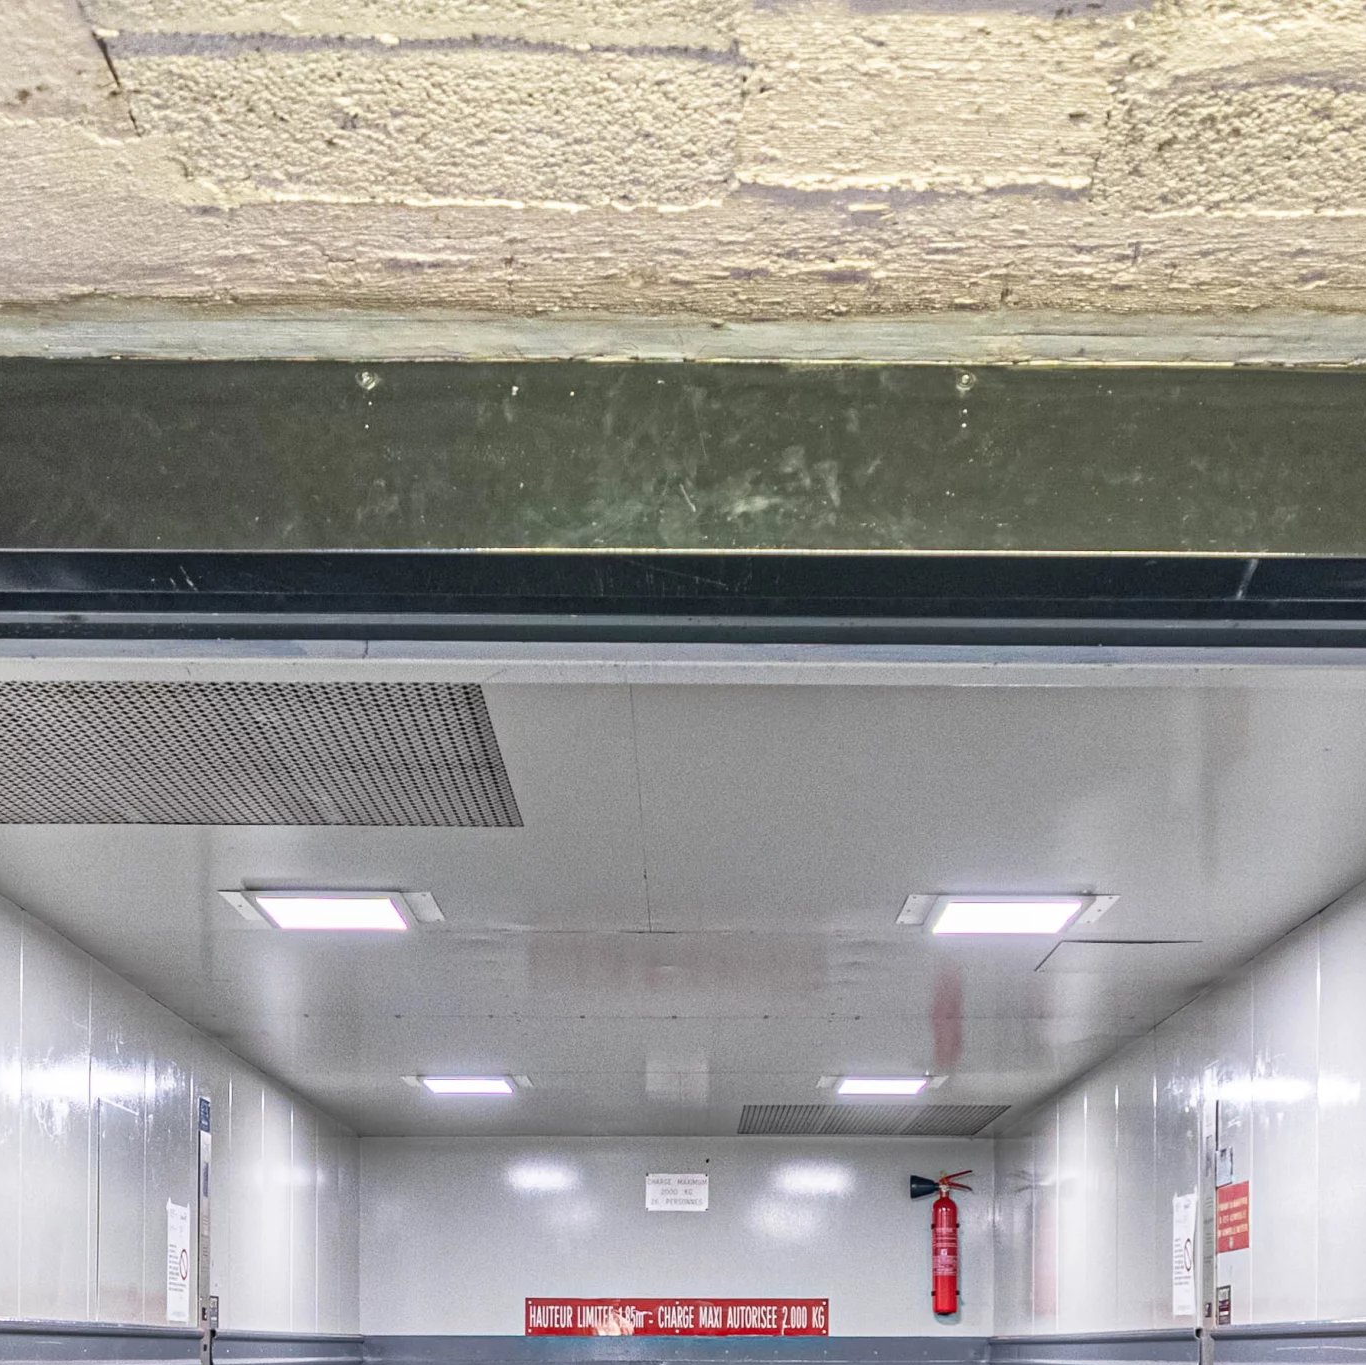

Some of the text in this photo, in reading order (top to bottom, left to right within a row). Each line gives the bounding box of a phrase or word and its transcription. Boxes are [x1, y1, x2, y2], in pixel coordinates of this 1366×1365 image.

[529, 1305, 573, 1329] HAUTEUR
[657, 1305, 695, 1329] CHARGE
[698, 1306, 723, 1329] MAXI
[726, 1306, 778, 1329] AUTORISEE
[781, 1306, 808, 1329] 2.000
[812, 1306, 825, 1329] KG
